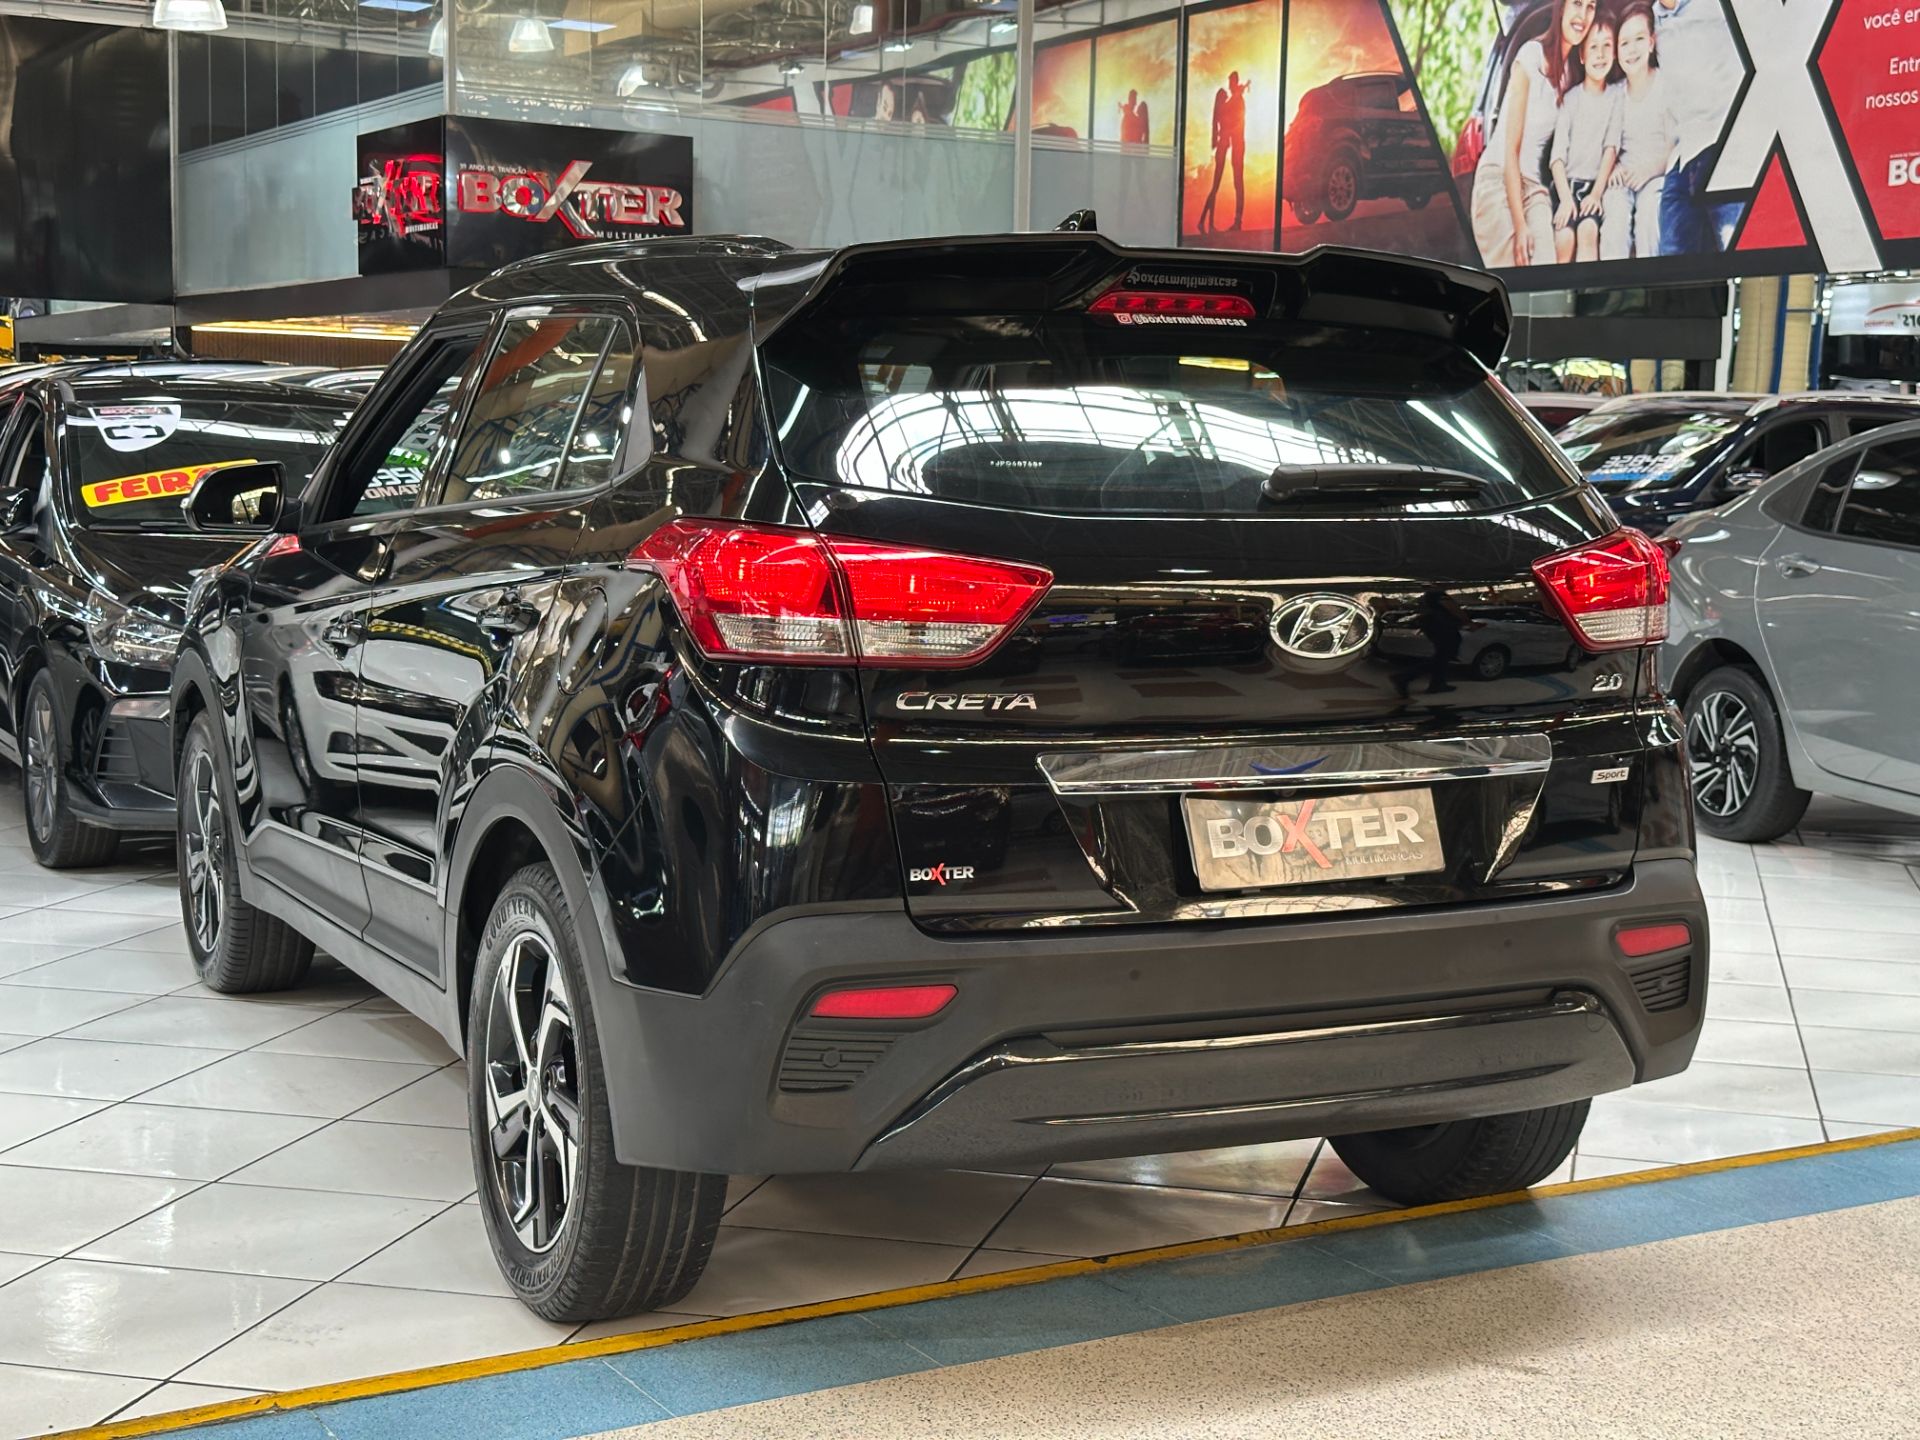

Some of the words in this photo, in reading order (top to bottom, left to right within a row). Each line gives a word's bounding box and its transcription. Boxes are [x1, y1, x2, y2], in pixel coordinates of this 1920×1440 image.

[1864, 9, 1900, 29] você
[1865, 90, 1918, 110] nossos
[457, 160, 686, 239] BOXTER
[1132, 314, 1248, 327] @boxtermultimarcas
[896, 691, 1037, 711] CRETA
[1596, 769, 1626, 781] Sport
[1206, 799, 1424, 869] BOXTER
[1345, 852, 1424, 865] MULTIMARCAS
[909, 863, 975, 886] BOXTER
